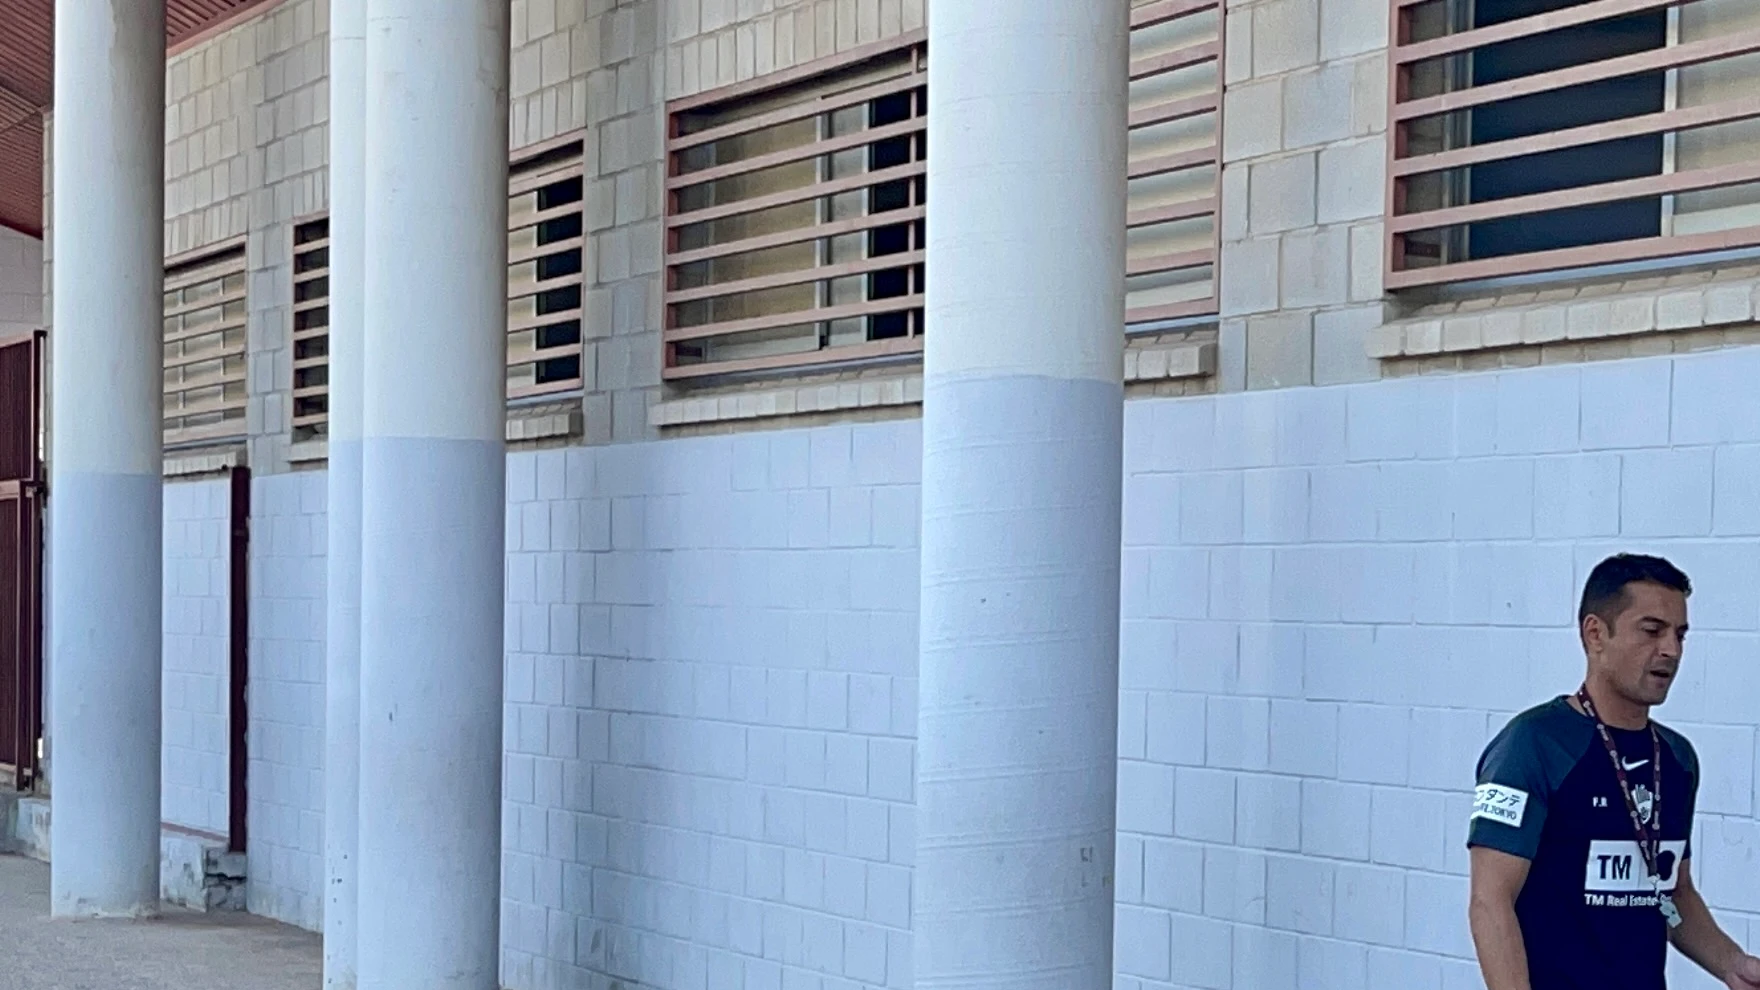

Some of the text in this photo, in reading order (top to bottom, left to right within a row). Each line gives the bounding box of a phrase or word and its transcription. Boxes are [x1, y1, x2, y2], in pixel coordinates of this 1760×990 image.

[1597, 854, 1632, 881] TM
[1583, 893, 1605, 906] TM
[1606, 895, 1628, 907] Real
